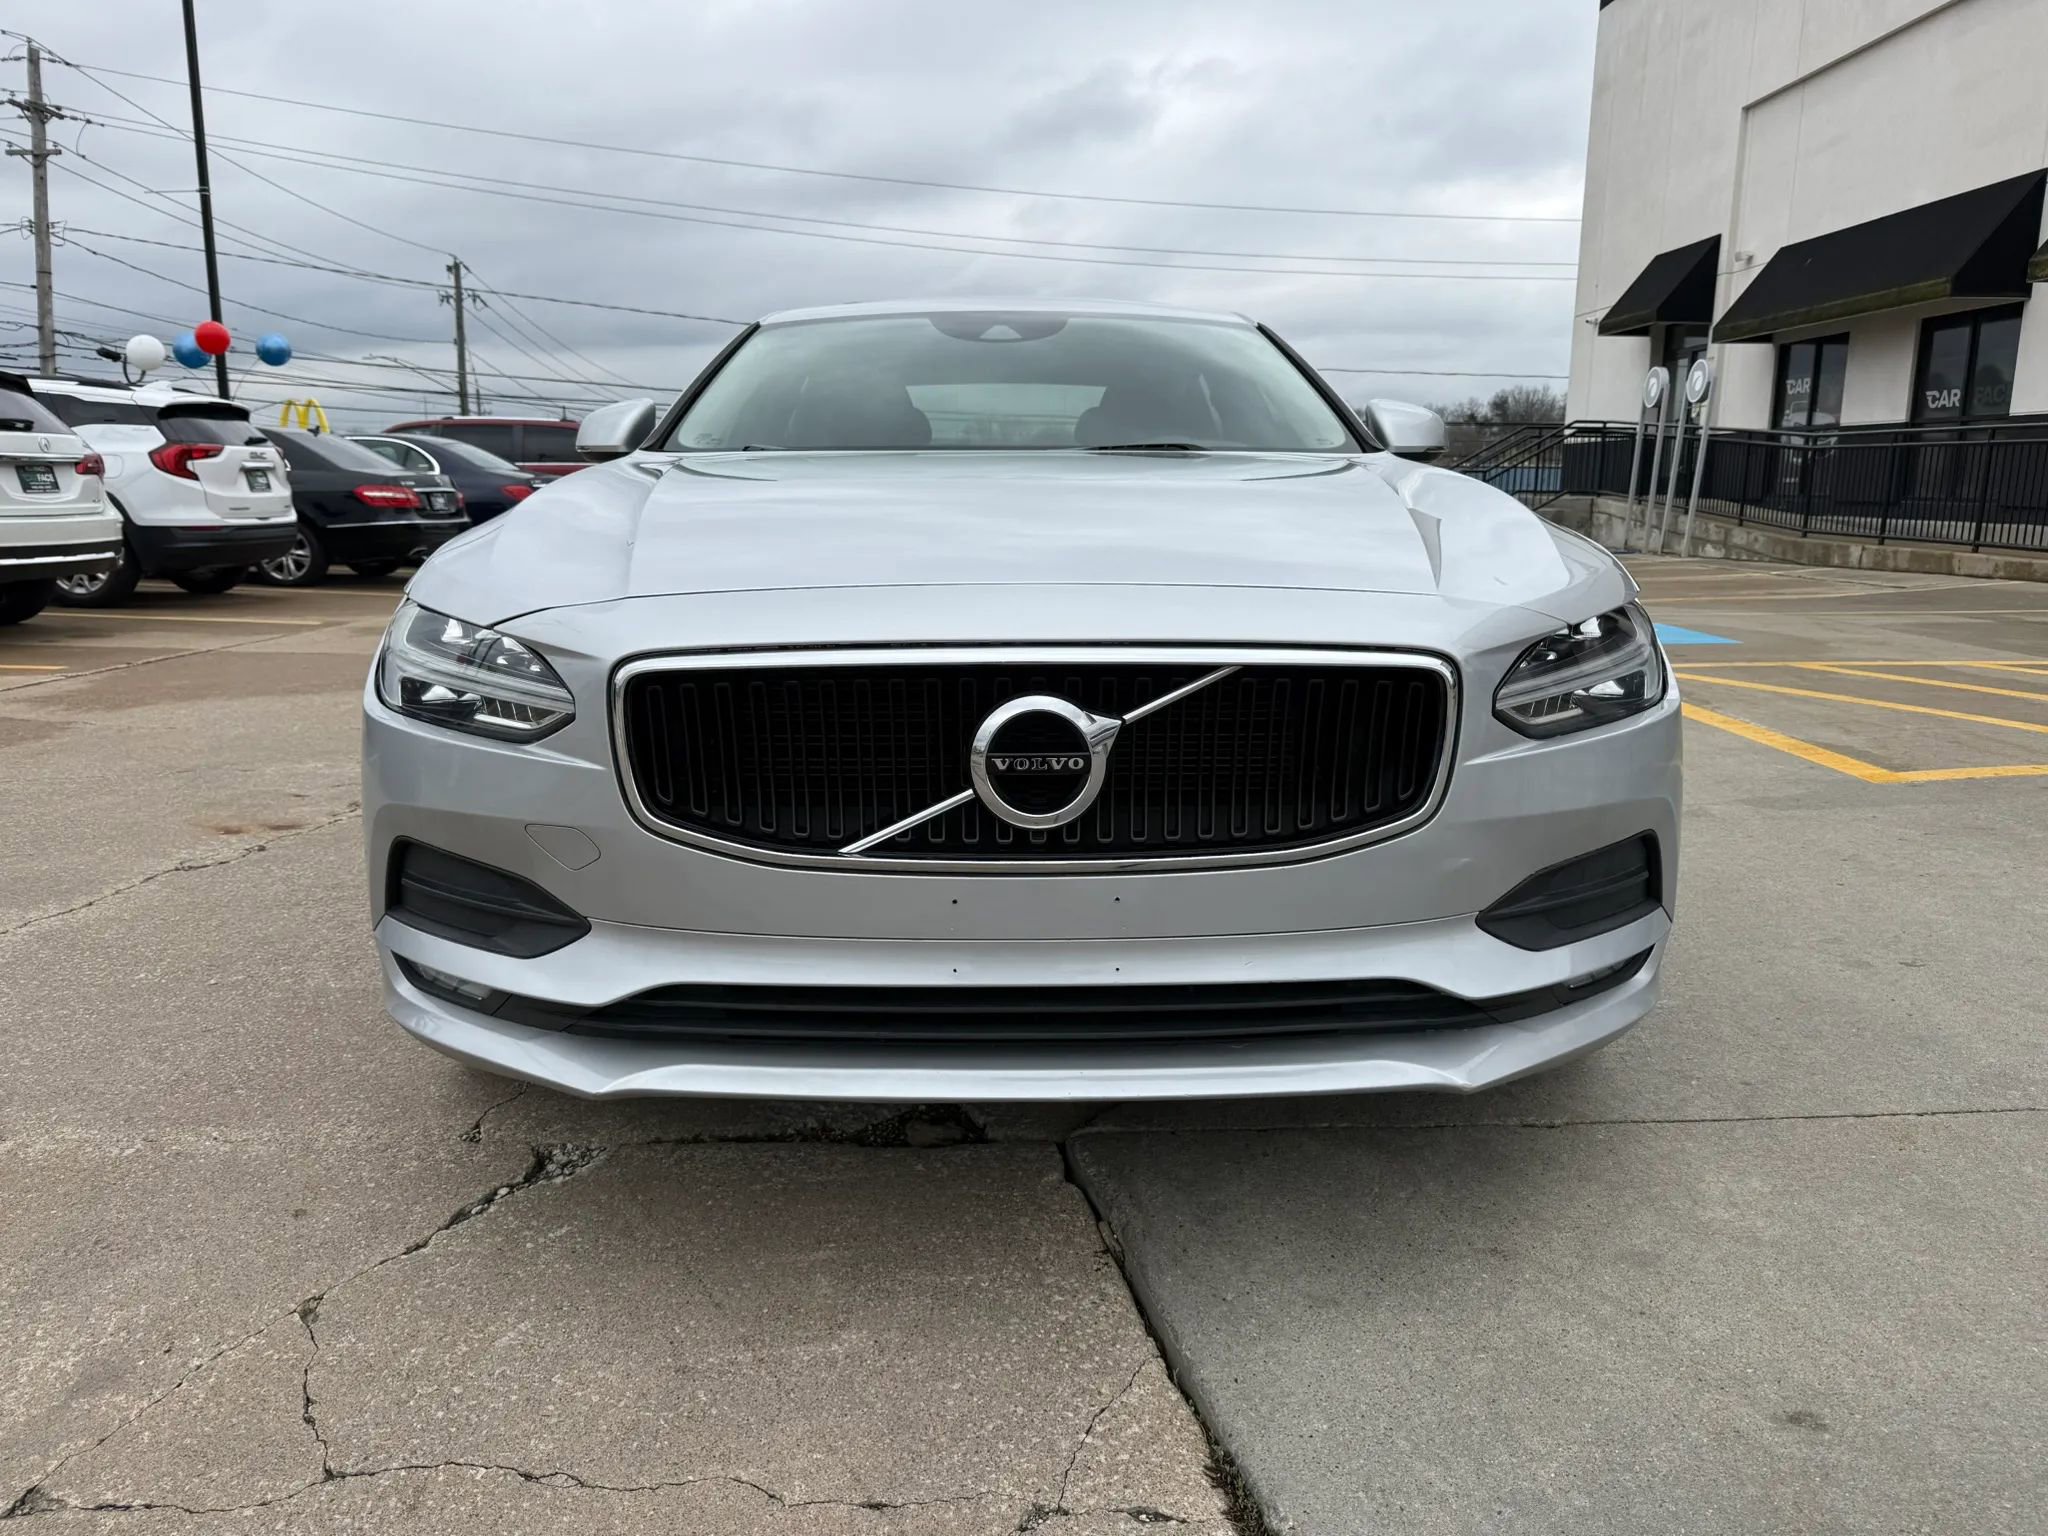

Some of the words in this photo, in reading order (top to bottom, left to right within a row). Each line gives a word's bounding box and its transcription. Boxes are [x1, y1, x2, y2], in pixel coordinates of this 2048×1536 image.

[1786, 378, 1811, 395] CAR
[1925, 389, 1961, 408] CAR
[991, 757, 1085, 770] VOLVO
